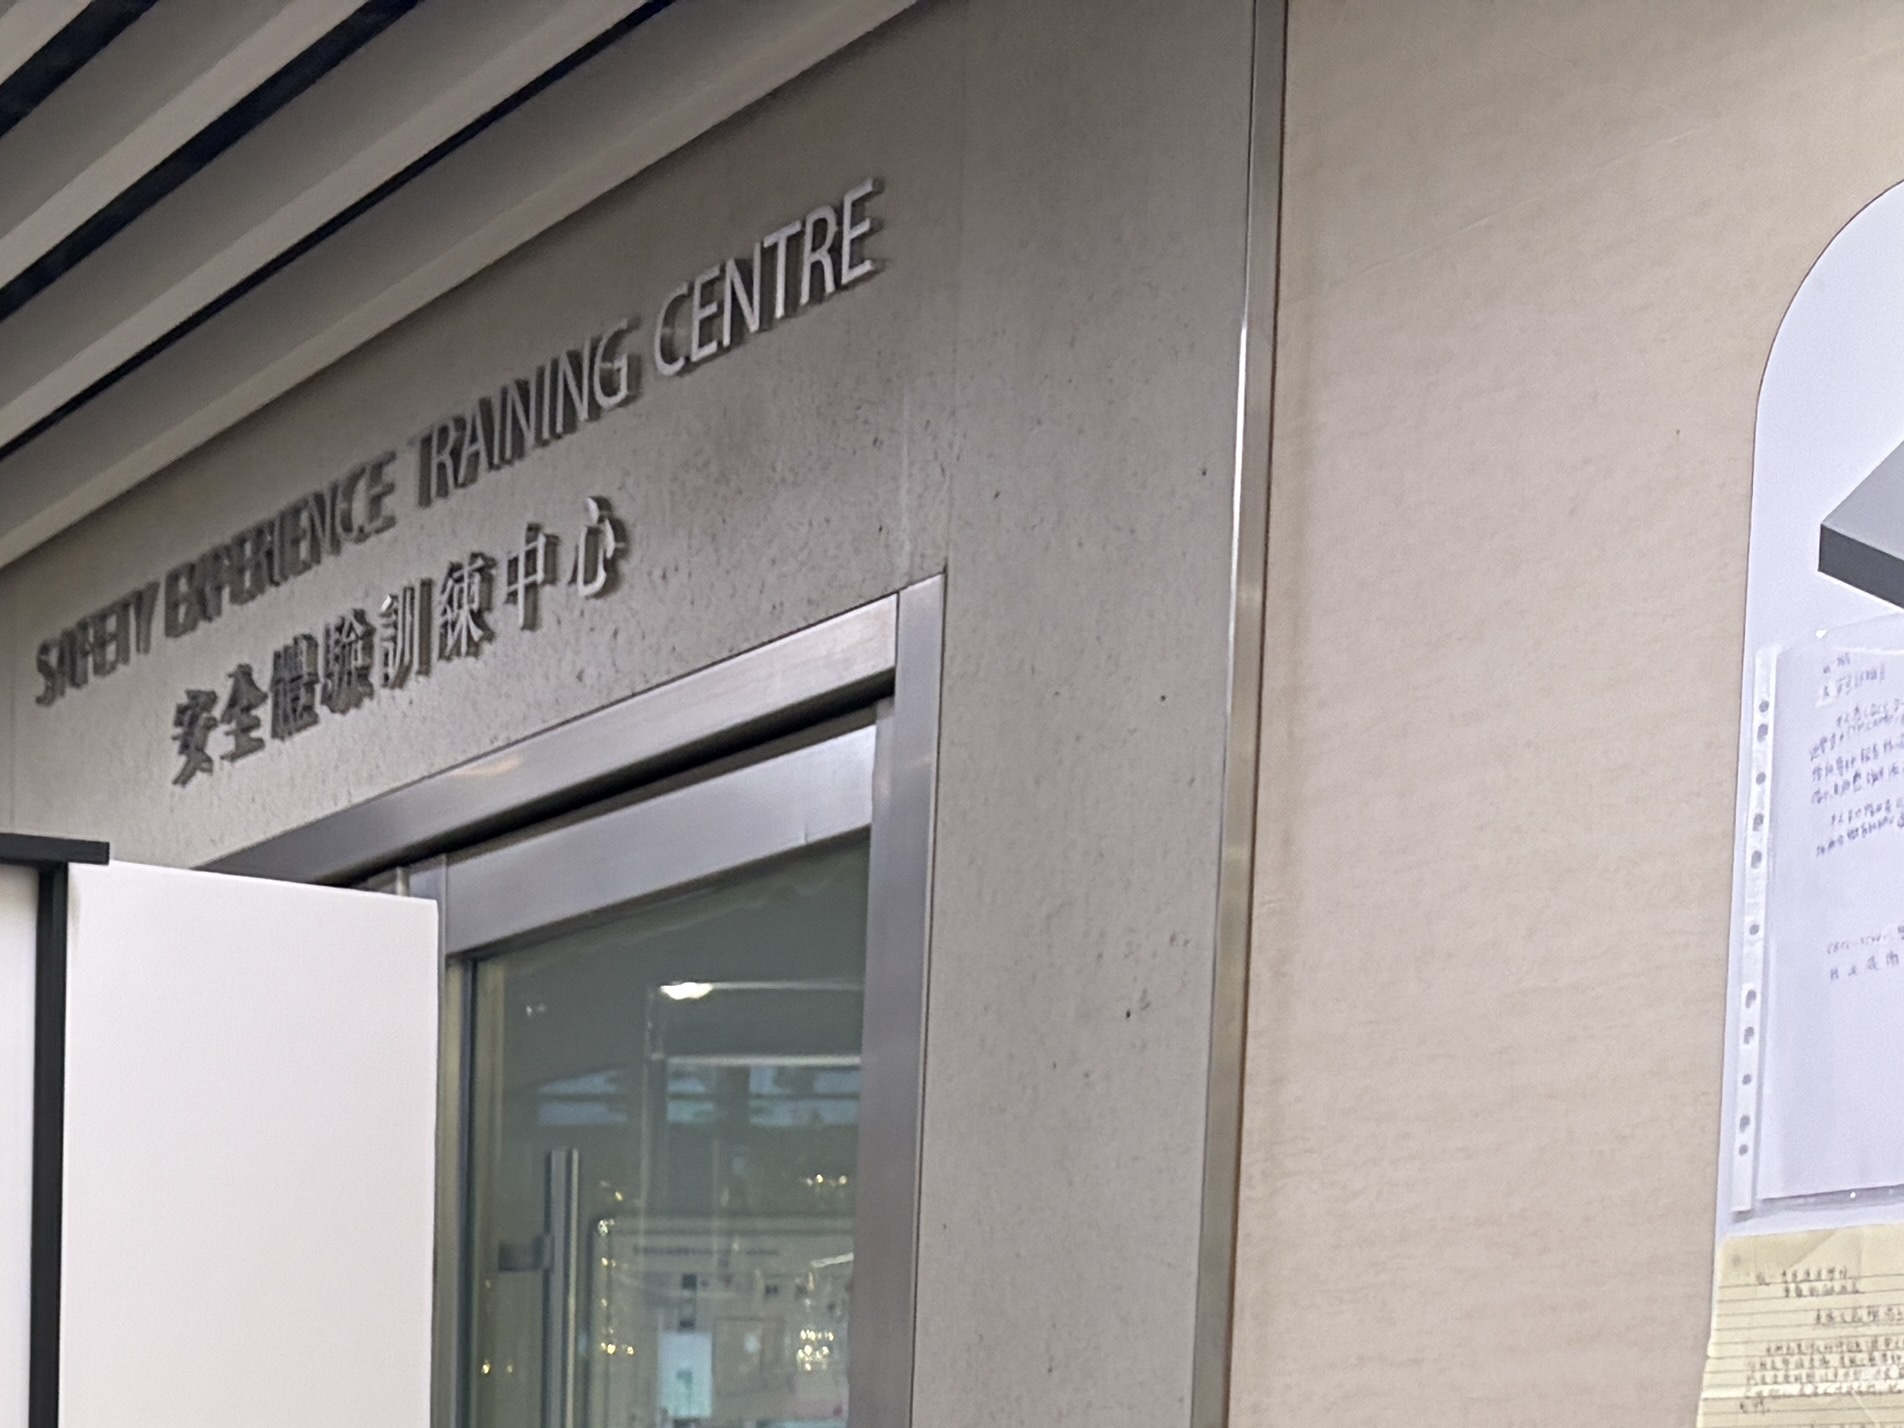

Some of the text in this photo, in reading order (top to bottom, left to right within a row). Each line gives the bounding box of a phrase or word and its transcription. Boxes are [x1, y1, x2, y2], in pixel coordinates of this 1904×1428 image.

[35, 177, 880, 706] SAFETY EXPERIENCE TRAINING CENTRE
[171, 496, 626, 786] 安全體驗訓練中心
